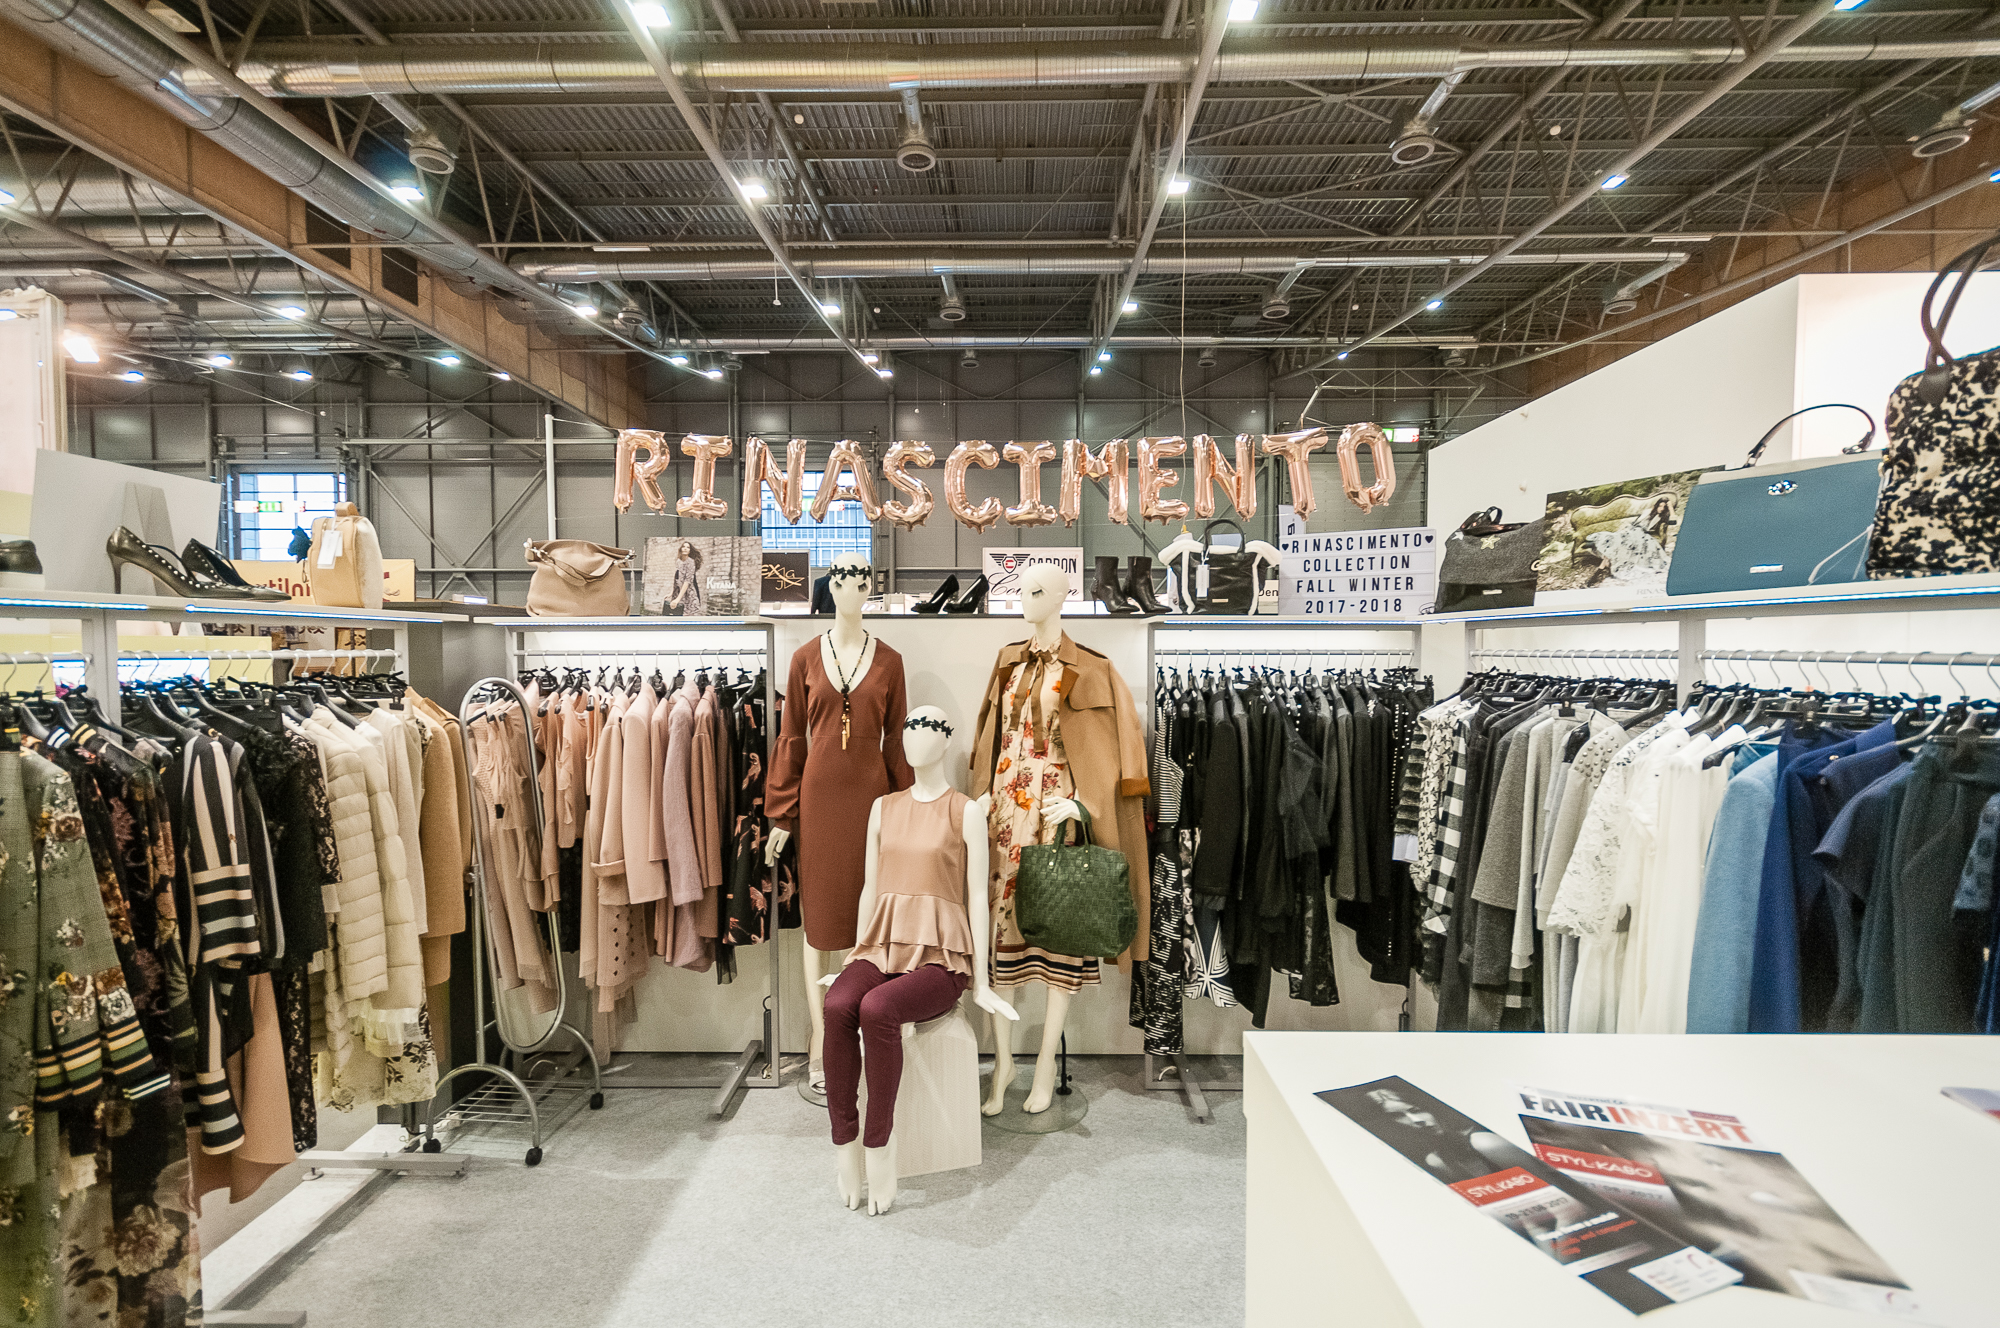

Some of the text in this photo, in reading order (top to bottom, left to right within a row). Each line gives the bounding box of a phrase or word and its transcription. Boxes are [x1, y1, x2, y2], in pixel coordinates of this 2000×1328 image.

[613, 421, 1396, 533] RINASCIMENTO
[1292, 533, 1422, 553] RINASCIMENTO
[1303, 555, 1410, 573] COLLECTION
[1296, 576, 1414, 593] FALL WINTER
[1305, 598, 1402, 614] 2017-2018
